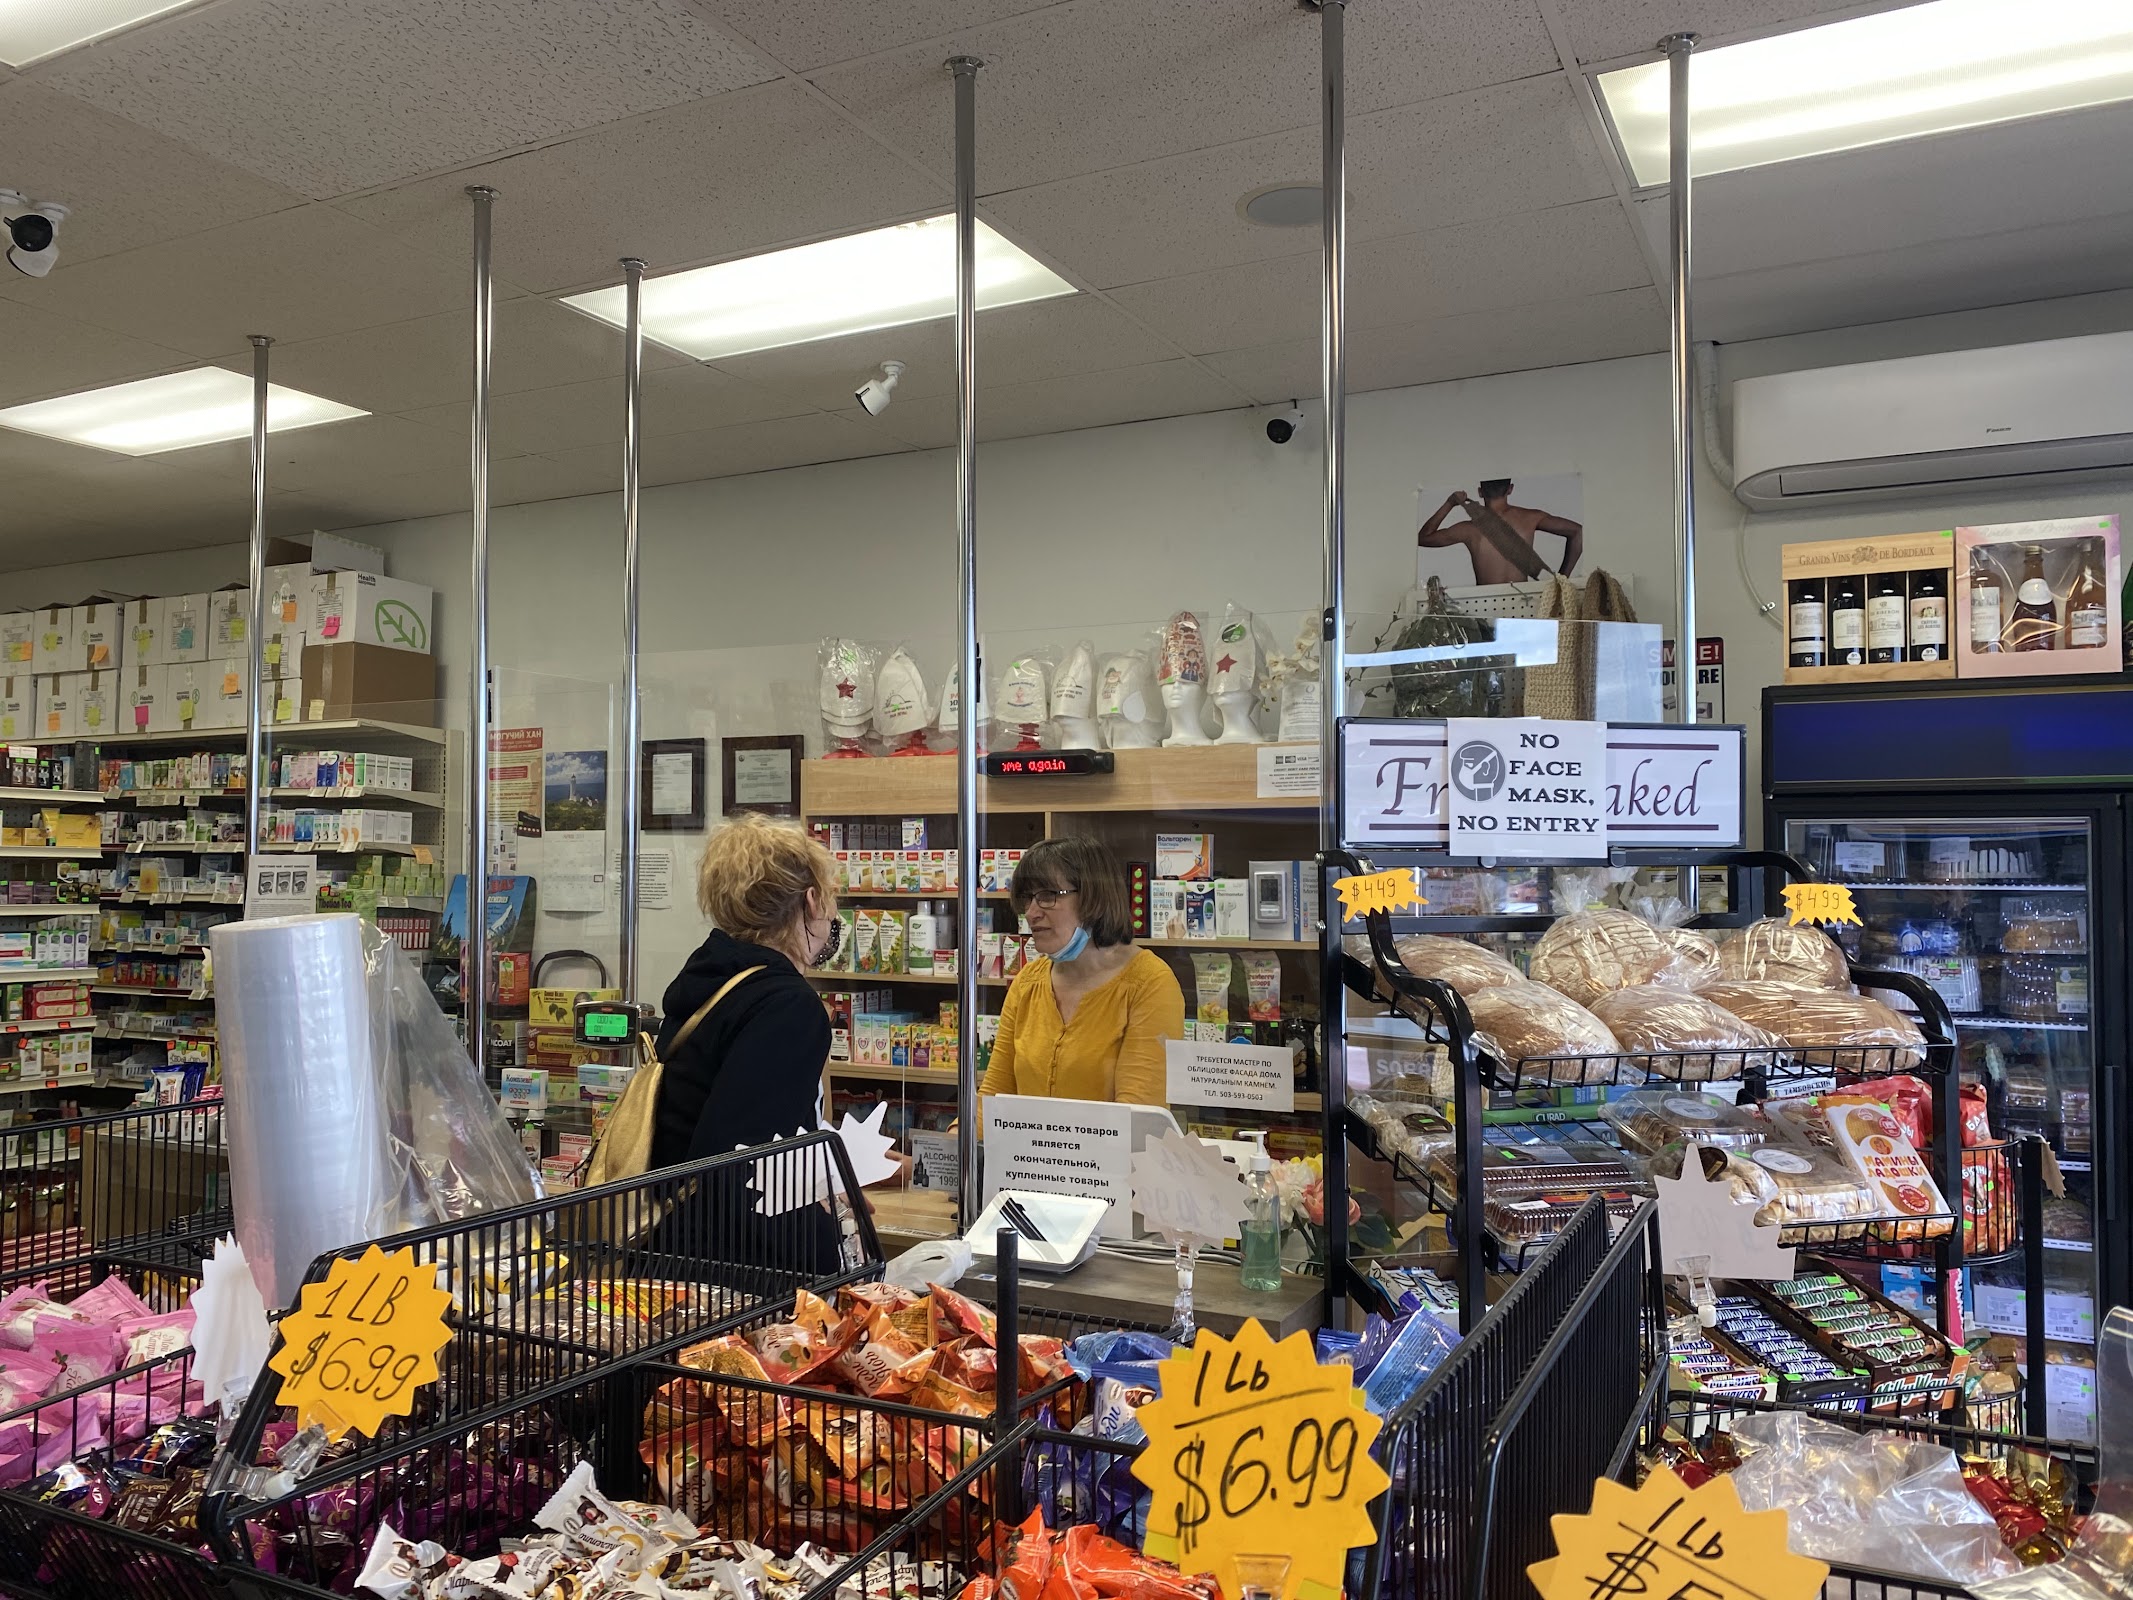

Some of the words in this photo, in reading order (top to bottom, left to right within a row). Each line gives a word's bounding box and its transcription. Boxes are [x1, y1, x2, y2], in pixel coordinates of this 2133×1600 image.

[1520, 733, 1560, 749] NO
[1028, 759, 1066, 772] again
[1509, 761, 1582, 776] FACE
[1606, 758, 1713, 817] aked
[1508, 788, 1595, 806] MASK,
[1457, 815, 1498, 831] NO
[1506, 816, 1600, 833] ENTRY
[1197, 1056, 1232, 1065] ТРЕБУЕТСЯ
[1233, 1058, 1260, 1066] МАСТЕР
[1187, 1066, 1228, 1075] ОБЛИЦОВКЕ
[1230, 1069, 1258, 1077] ФАСАДА
[1191, 1076, 1242, 1086] НАТУРАЛЬНЫМ
[1244, 1080, 1277, 1089] КАМНЕМ.
[1220, 1091, 1263, 1101] 503-593-0503
[994, 1118, 1043, 1131] Продажа
[1046, 1123, 1072, 1133] всех
[1075, 1126, 1119, 1138] товаров
[1031, 1139, 1081, 1151] является
[1013, 1154, 1100, 1171] окончательной,
[1862, 1156, 1920, 1166] МАМИНЫ
[1005, 1170, 1066, 1184] купленные
[1069, 1175, 1109, 1188] товары
[1867, 1166, 1928, 1178] ЛАДОШКИ
[939, 1175, 958, 1187] 1999
[1372, 1268, 1391, 1288] Dove
[314, 1279, 348, 1318] 1
[347, 1272, 408, 1326] LB
[287, 1331, 420, 1401] $6.99
[1194, 1350, 1211, 1406] 1
[1174, 1417, 1358, 1554] $6.99
